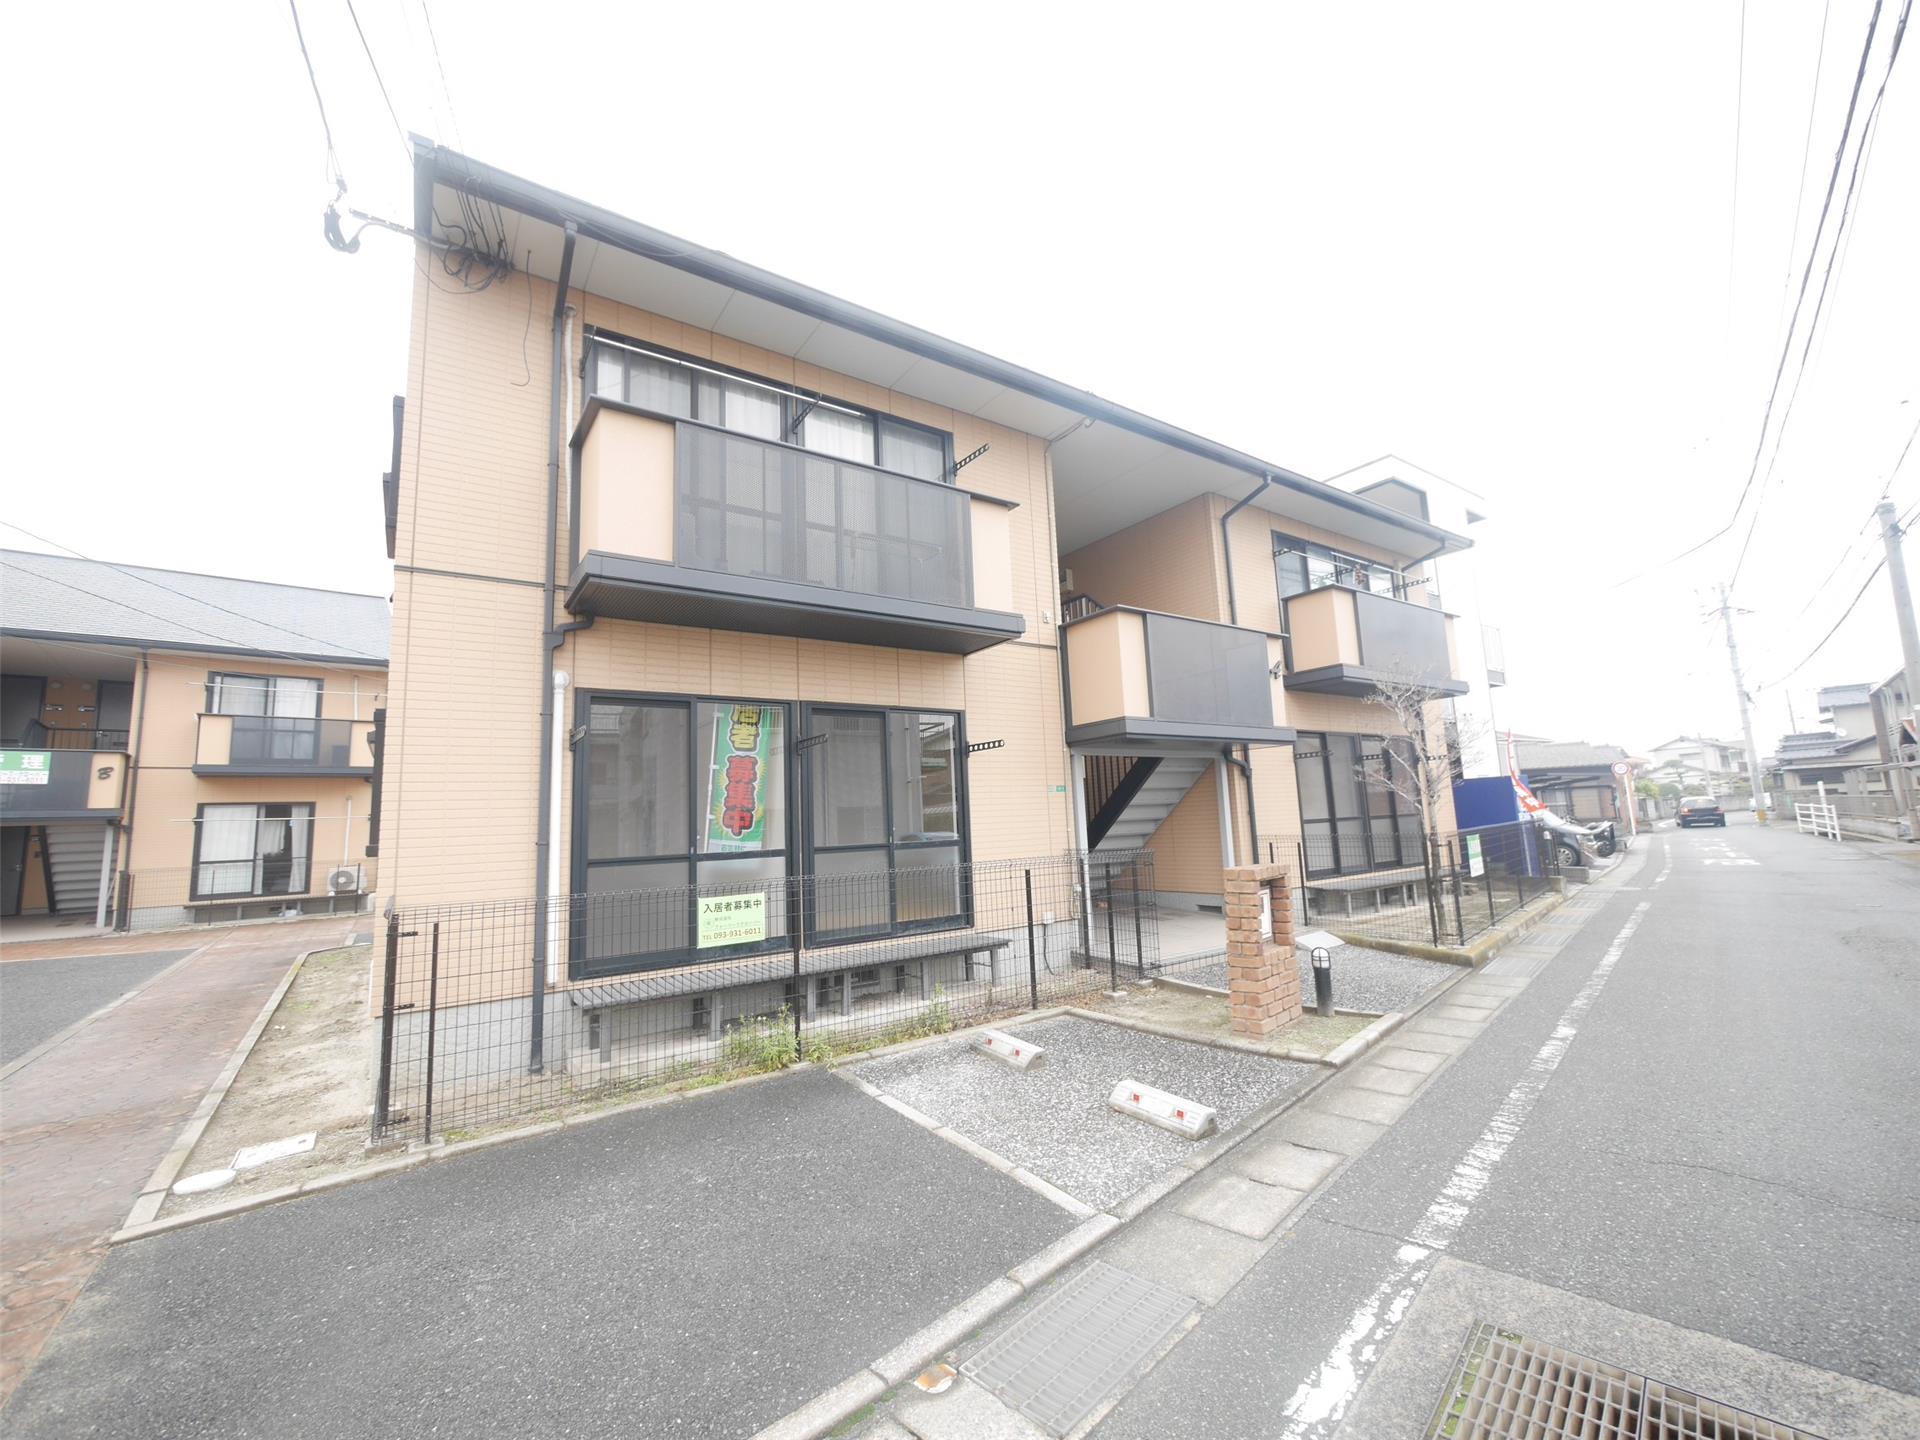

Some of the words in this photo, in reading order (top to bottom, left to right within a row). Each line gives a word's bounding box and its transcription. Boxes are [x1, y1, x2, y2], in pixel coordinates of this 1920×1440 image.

[703, 899, 762, 913] 入居者募集中
[714, 928, 761, 940] 093-931-6011
